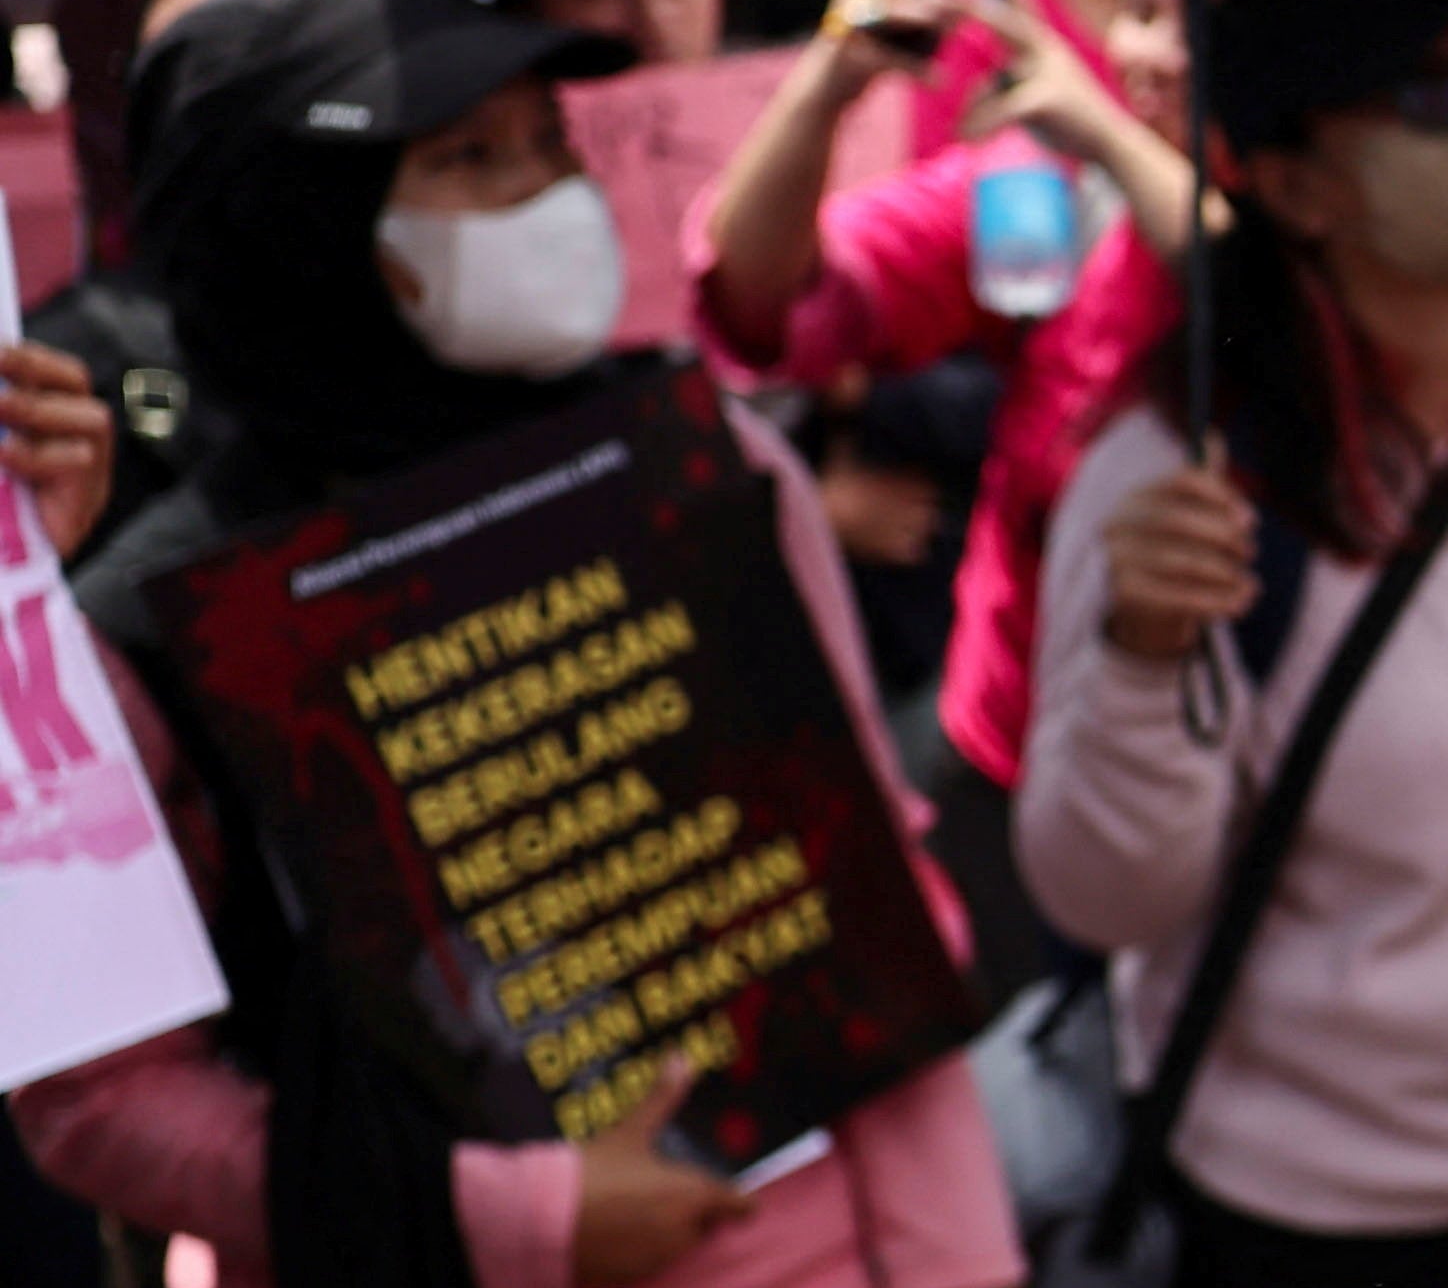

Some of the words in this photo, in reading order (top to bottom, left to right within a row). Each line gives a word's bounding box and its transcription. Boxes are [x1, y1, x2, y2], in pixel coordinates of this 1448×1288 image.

[345, 556, 628, 721] HENTIKAN
[378, 599, 698, 785] KEKERASAN
[408, 676, 693, 849] BERULANG
[437, 767, 663, 911] NEGARA
[466, 795, 742, 966] TERHADAP
[500, 835, 808, 1029] PEREMPUAN
[522, 993, 642, 1090] DAN
[636, 886, 831, 1025] RAKYAT
